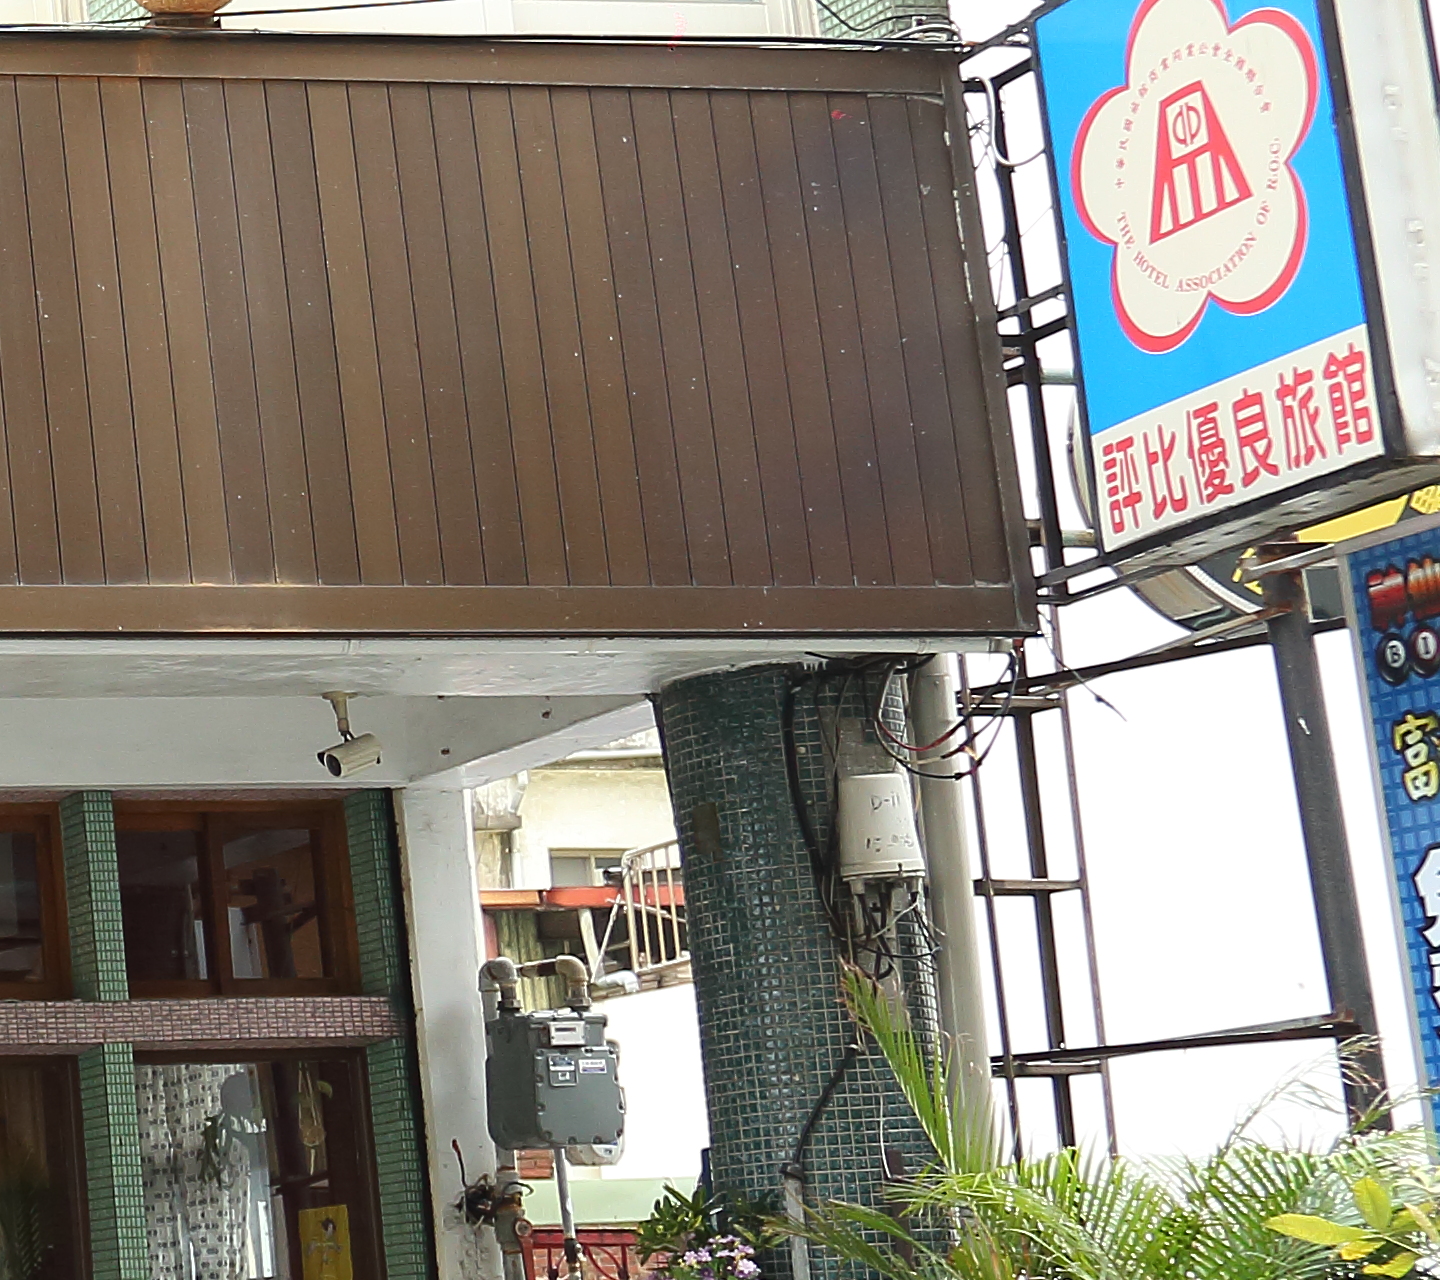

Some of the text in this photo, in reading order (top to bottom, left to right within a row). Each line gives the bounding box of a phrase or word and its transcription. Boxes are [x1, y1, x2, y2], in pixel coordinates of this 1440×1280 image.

[1116, 211, 1135, 250] THE
[1133, 249, 1171, 290] HOTEL
[1174, 231, 1258, 293] ASSOCIATION
[1255, 199, 1271, 226] OF
[1100, 342, 1374, 537] 評比優良旅館
